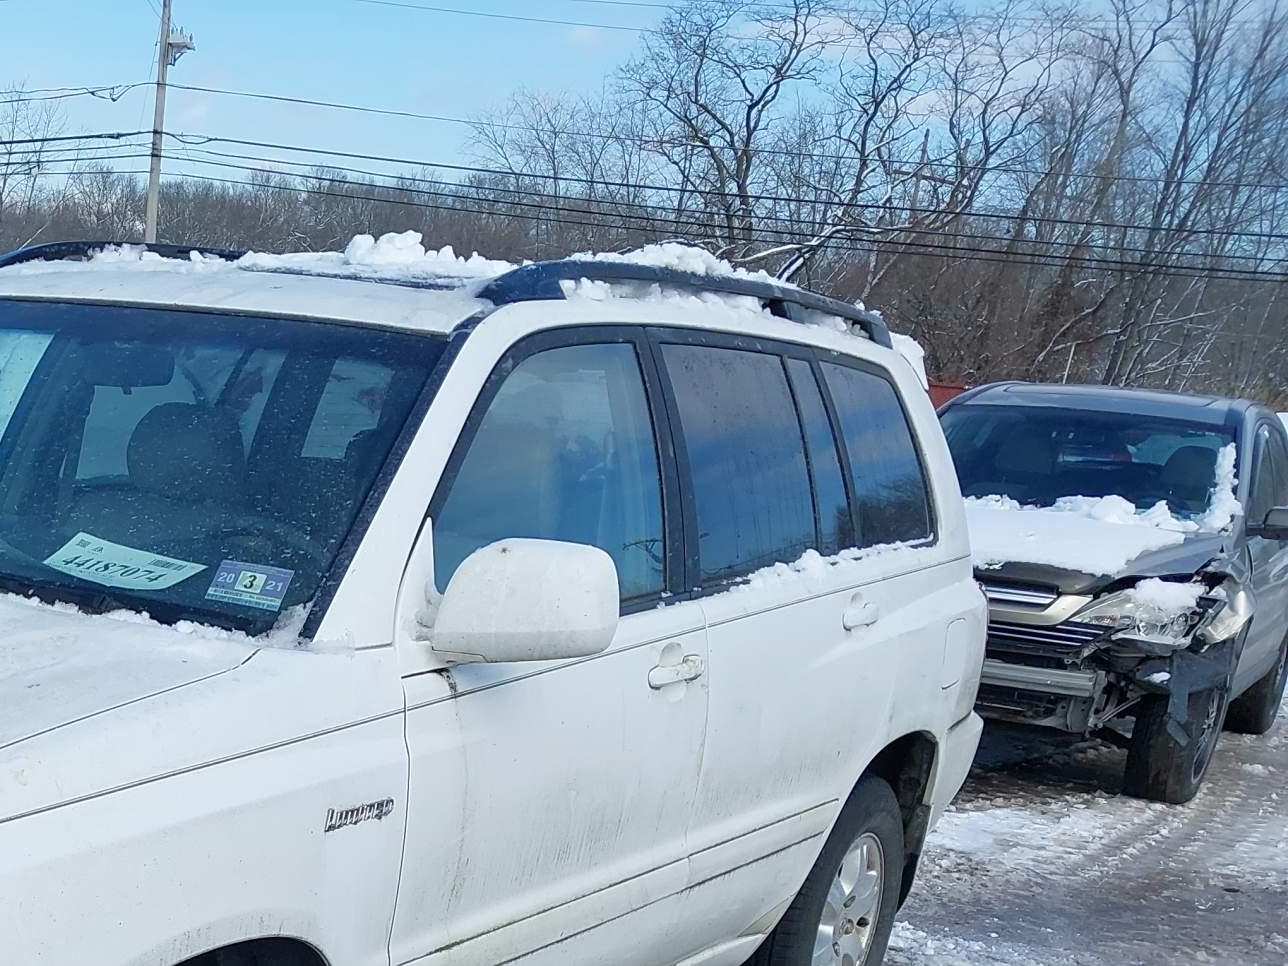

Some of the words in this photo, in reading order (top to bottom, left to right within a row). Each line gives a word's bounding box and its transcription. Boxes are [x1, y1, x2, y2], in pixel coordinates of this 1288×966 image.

[62, 554, 168, 583] 44187074
[217, 572, 235, 584] 20
[243, 574, 258, 590] 3
[265, 580, 284, 592] 21
